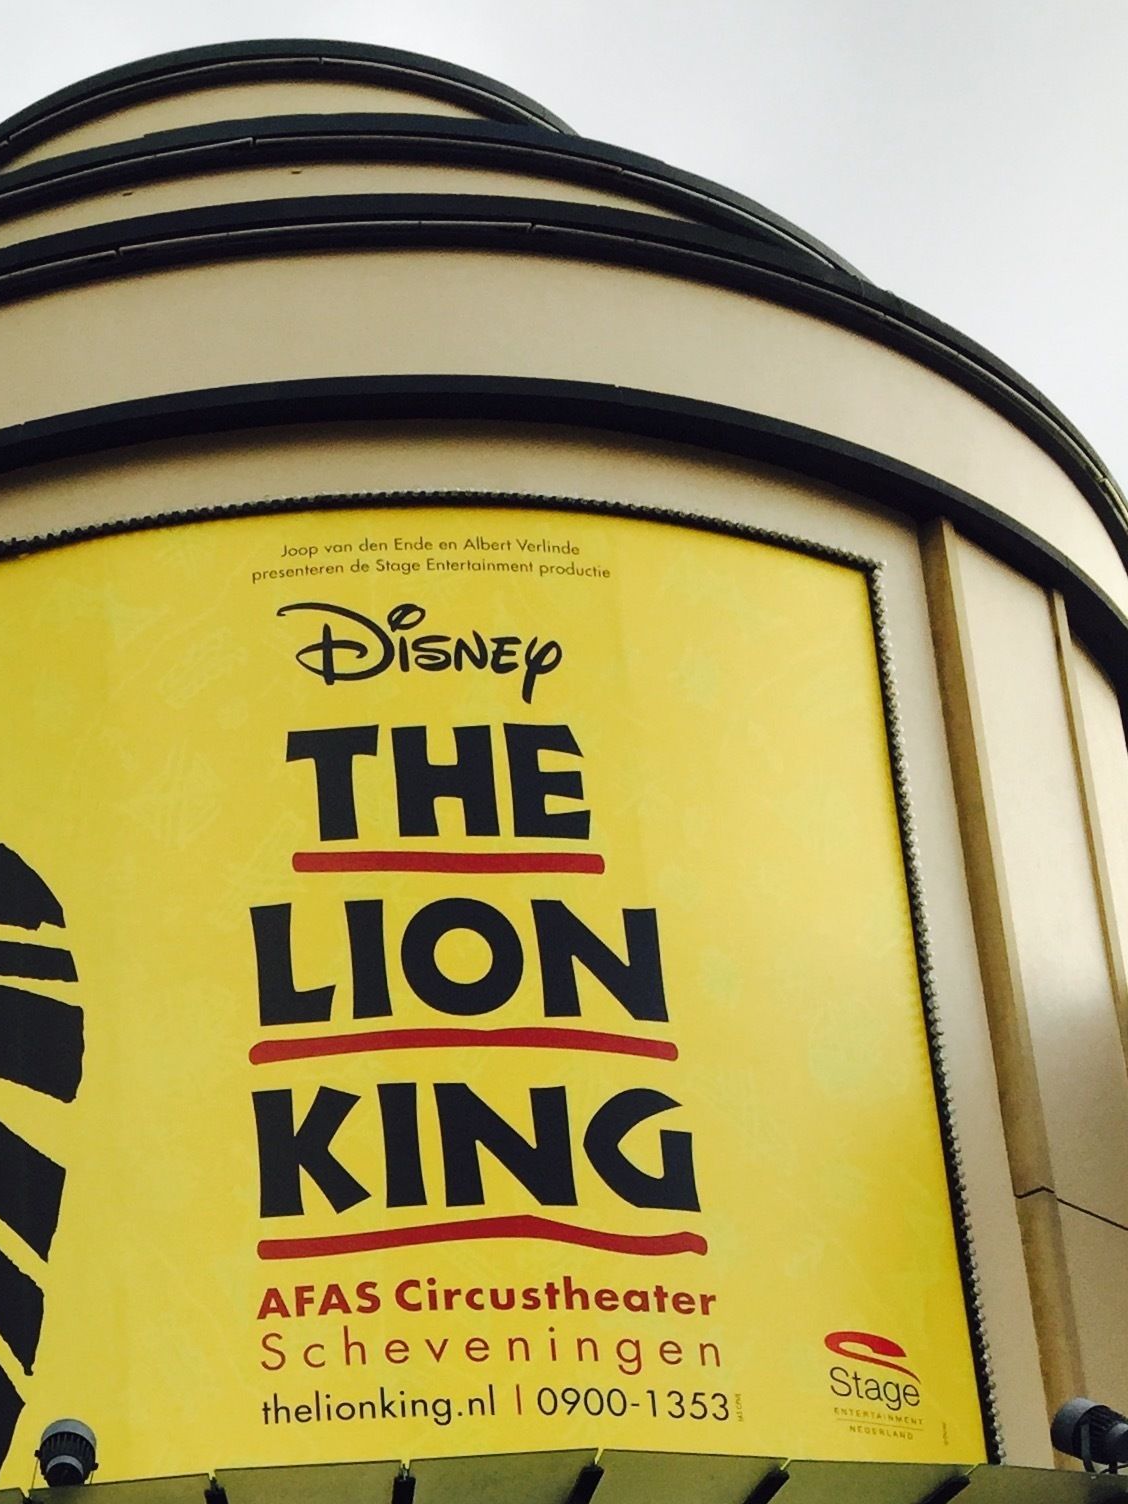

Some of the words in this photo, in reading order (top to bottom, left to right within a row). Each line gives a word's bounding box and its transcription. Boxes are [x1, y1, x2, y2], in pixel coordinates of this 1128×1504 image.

[281, 545, 318, 558] Joop
[325, 540, 352, 553] van
[359, 538, 387, 551] den
[394, 536, 432, 550] Ende
[439, 542, 457, 550] en
[464, 536, 511, 550] Albert
[516, 539, 579, 555] Verlinde
[252, 565, 343, 584] presenteren
[350, 559, 369, 573] de
[376, 559, 420, 575] Stage
[427, 558, 533, 572] Entertainment
[539, 562, 610, 578] productie
[285, 722, 592, 842] THE
[249, 897, 670, 1027] LION
[251, 1081, 702, 1218] KING
[257, 1282, 380, 1319] AFAS
[395, 1276, 716, 1315] Circustheater
[261, 1325, 720, 1375] Scheveningen
[262, 1384, 495, 1425] thelionking.nl
[537, 1388, 729, 1421] 0900-1353
[829, 1366, 921, 1412] Stage
[833, 1407, 924, 1425] ENTERTAINMENT
[849, 1425, 914, 1440] NEDERLAND
